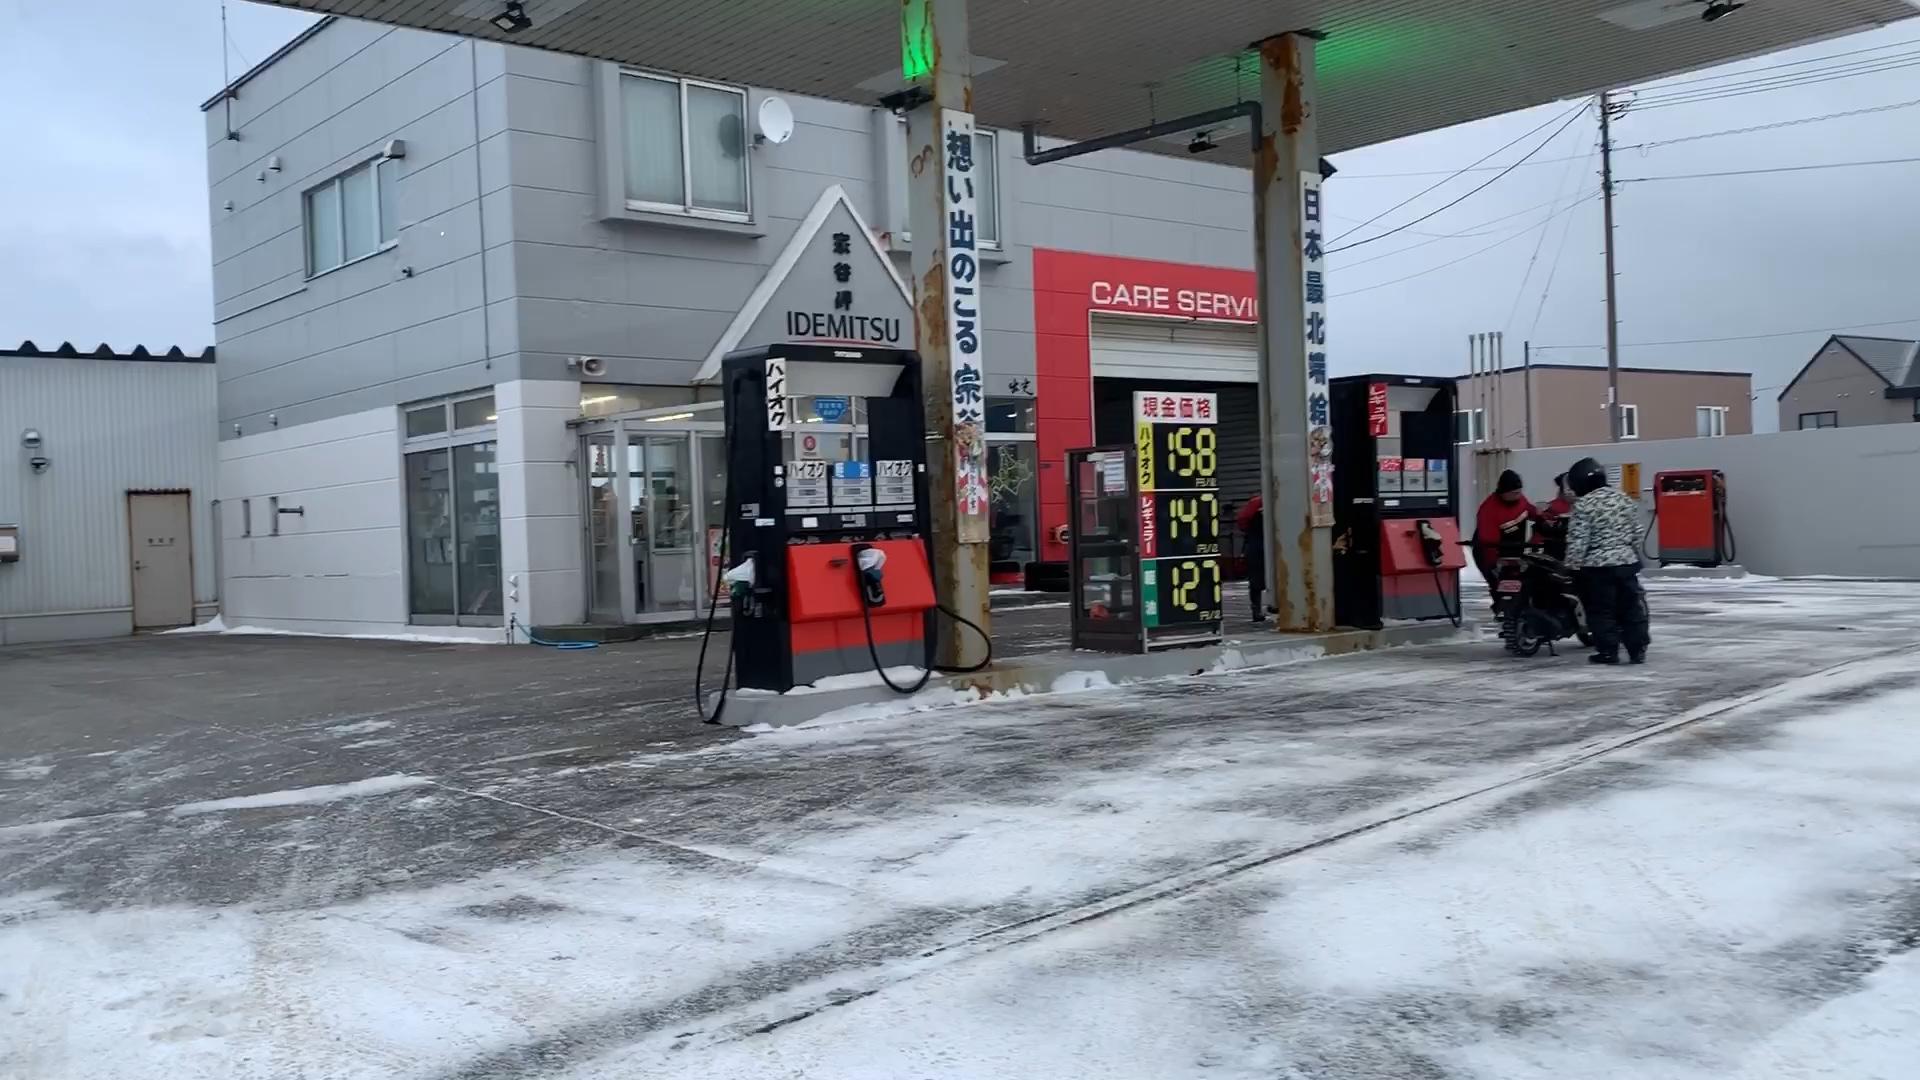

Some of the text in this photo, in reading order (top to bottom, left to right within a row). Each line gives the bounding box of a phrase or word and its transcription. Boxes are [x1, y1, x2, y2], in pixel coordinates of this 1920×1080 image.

[1092, 281, 1257, 317] CARE SERVI
[787, 311, 900, 342] IDEMITSU
[766, 363, 785, 426] ハイオク
[1143, 397, 1210, 419] 現金価格
[788, 462, 825, 478] ハイオク
[879, 461, 912, 477] ハイオク
[1140, 427, 1151, 485] ハイオク
[1167, 427, 1217, 476] 158
[1141, 496, 1155, 554] レギュラー
[1169, 493, 1218, 539] 147
[1172, 559, 1221, 612] 127
